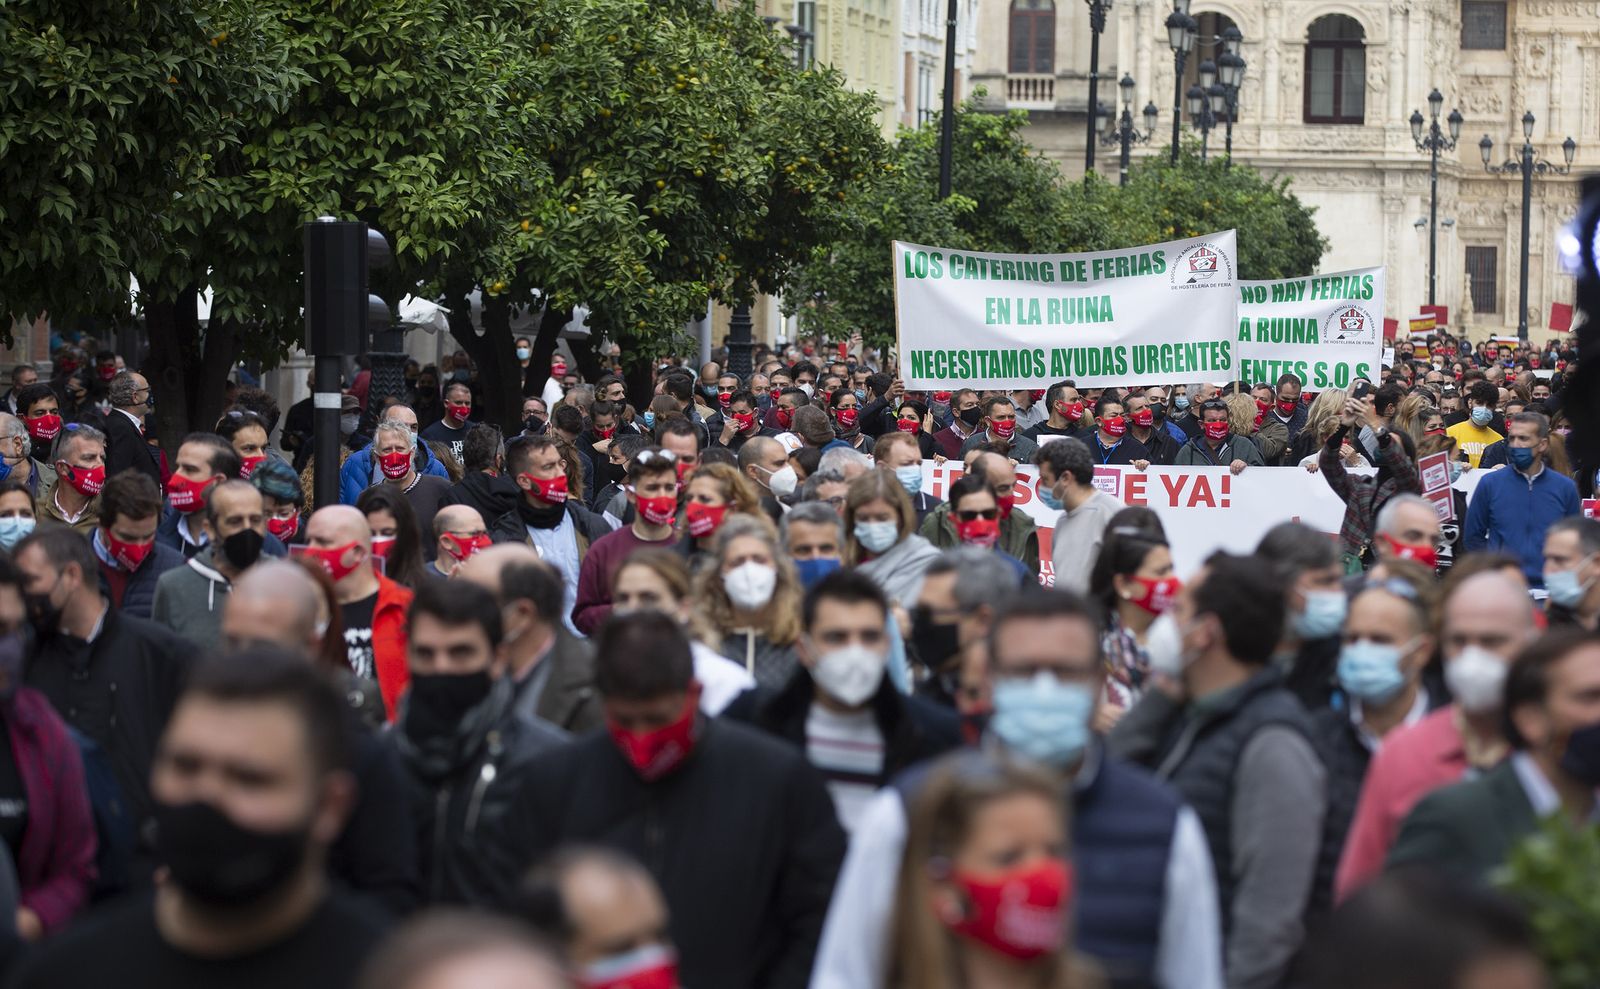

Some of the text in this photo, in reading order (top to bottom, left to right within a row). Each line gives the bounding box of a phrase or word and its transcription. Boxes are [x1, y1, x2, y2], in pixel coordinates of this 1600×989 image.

[904, 250, 1167, 283] LOS CATERING DE FERIAS
[1181, 242, 1208, 255] ANDALUZA
[1215, 247, 1232, 281] EMPRESARIOS
[1240, 274, 1374, 305] NO HAY FERIAS
[985, 295, 1114, 325] EN LA RUINA
[1255, 317, 1319, 345] RUINA
[910, 340, 1232, 380] NECESITAMOS AYUDAS URGENTES
[1160, 474, 1231, 508] YA!
